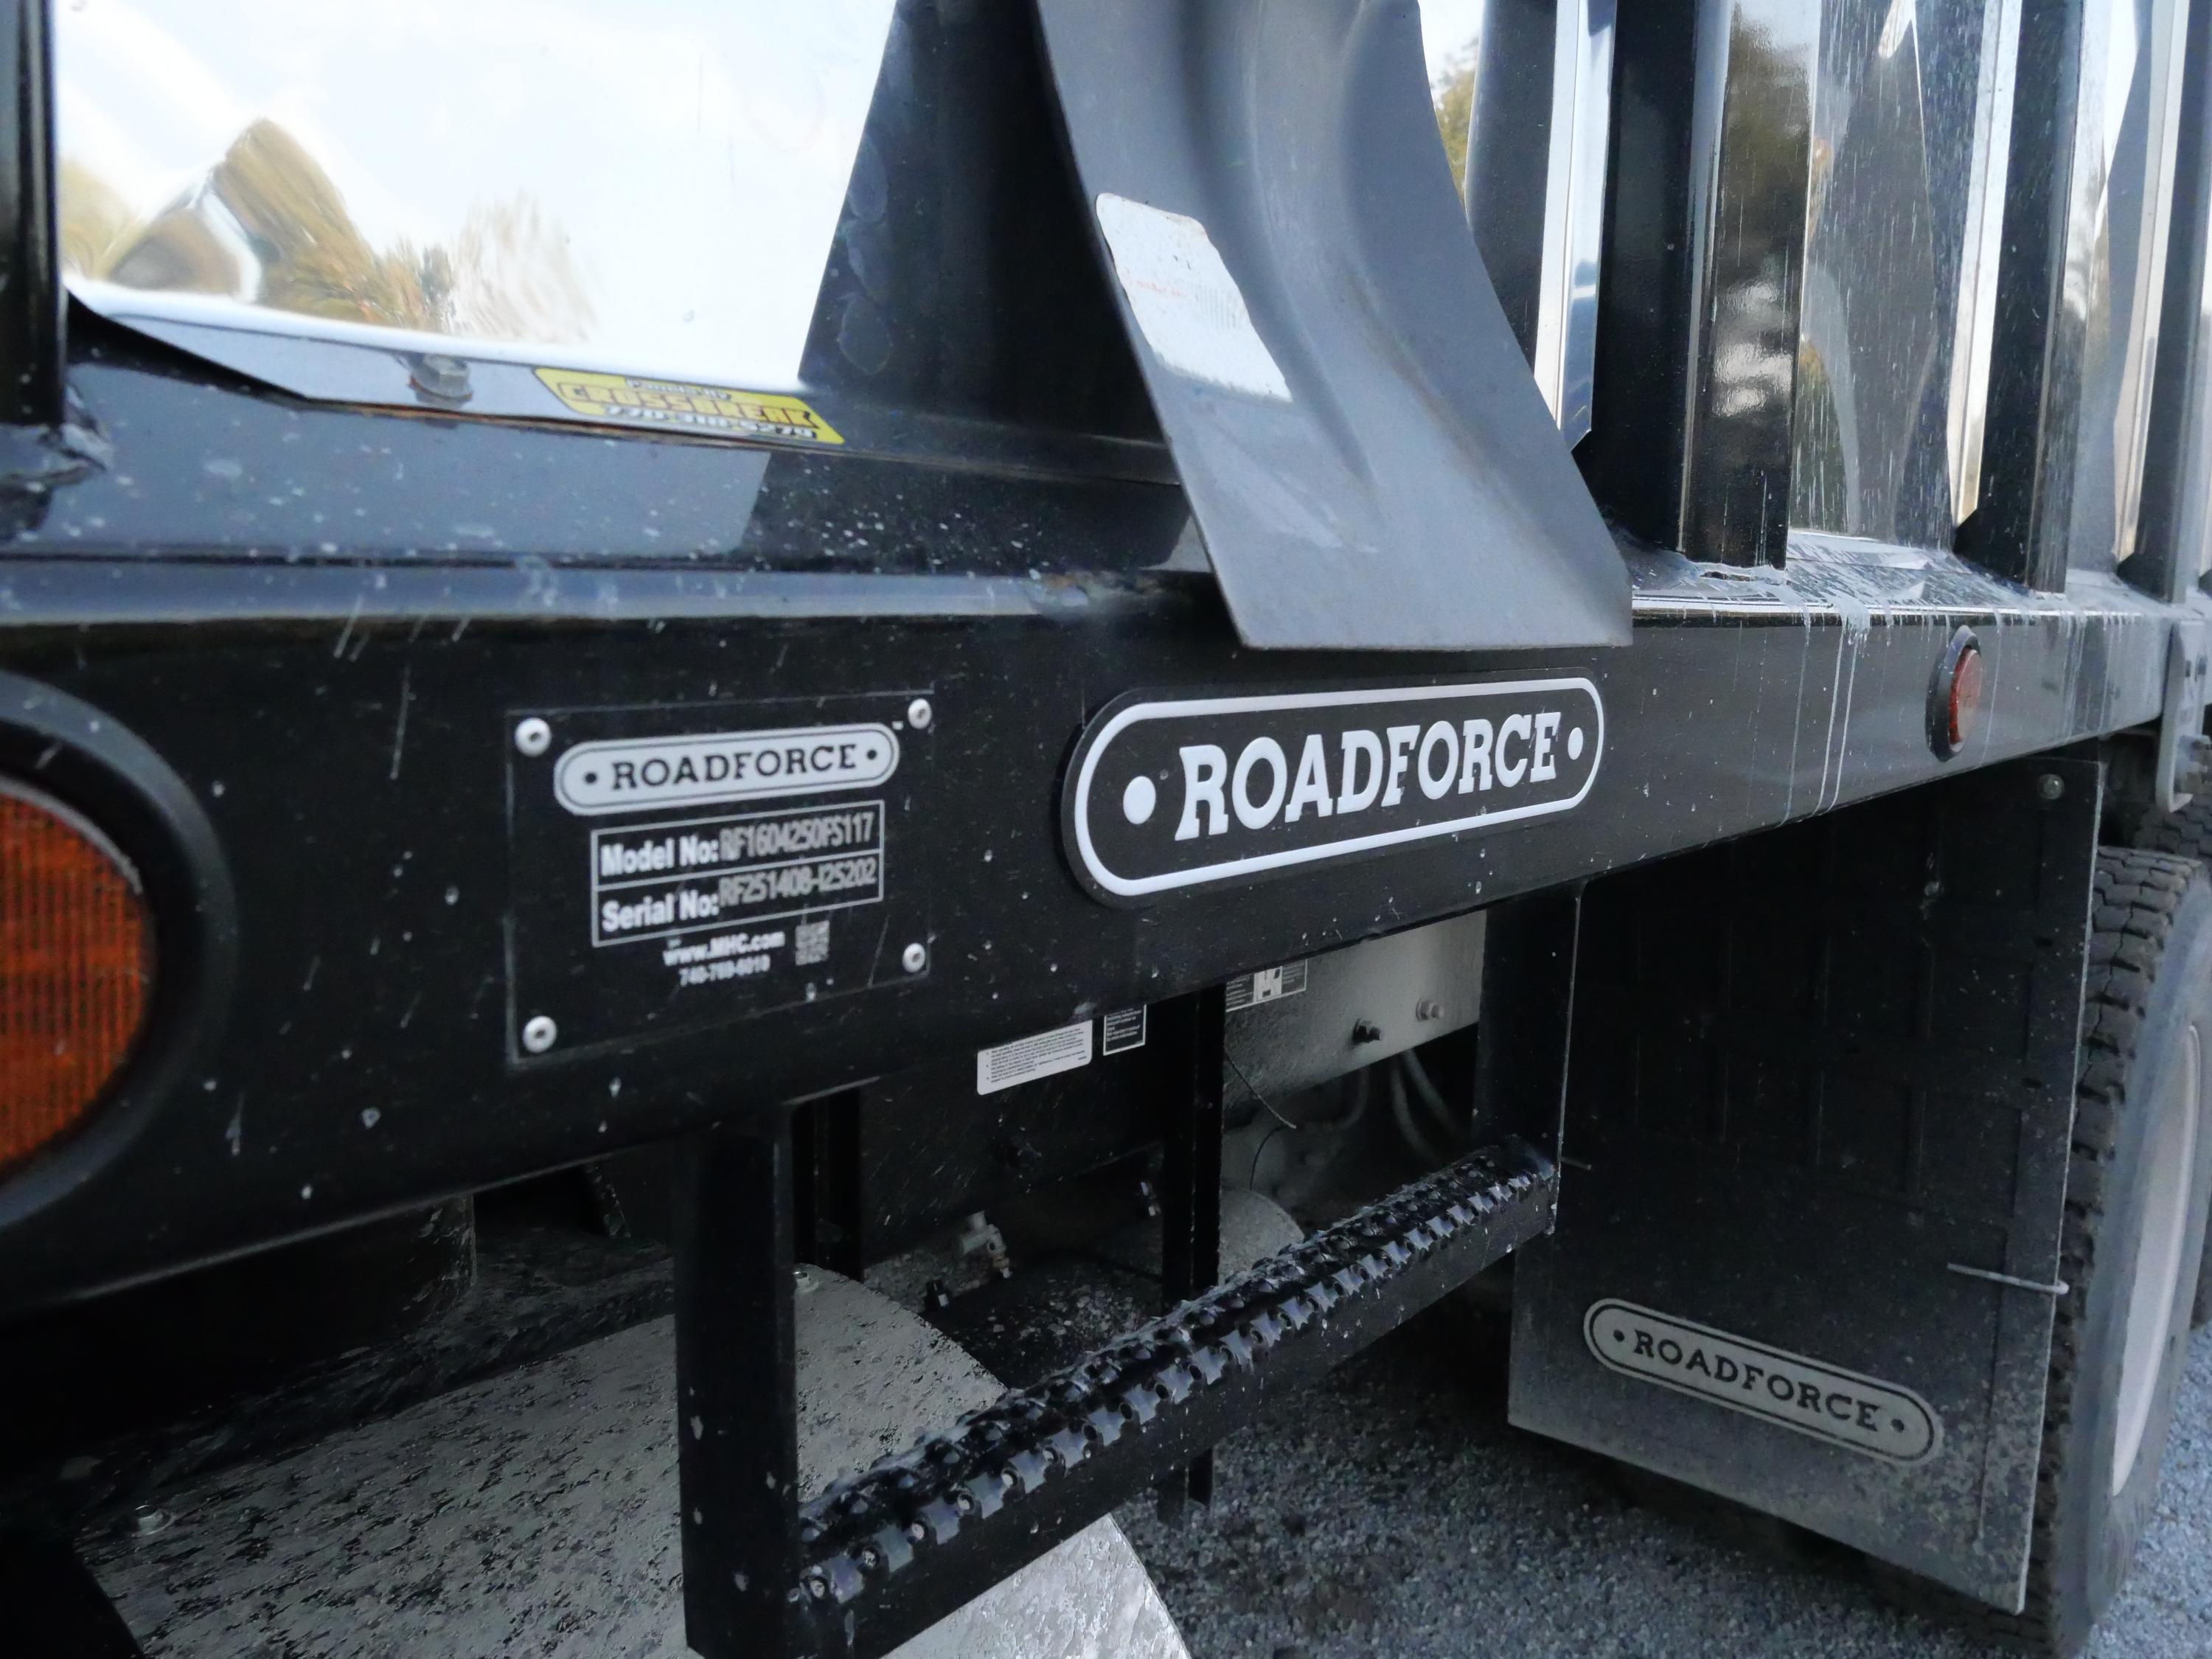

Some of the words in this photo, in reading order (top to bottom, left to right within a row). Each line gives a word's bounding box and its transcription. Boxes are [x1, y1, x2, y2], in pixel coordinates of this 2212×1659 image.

[611, 743, 857, 790] ROADFORCE
[1175, 711, 1562, 841] ROADFORCE
[600, 838, 674, 876] Model
[678, 835, 720, 868] No:
[601, 891, 674, 933] Serial
[678, 887, 720, 917] No:
[1632, 1328, 1883, 1432] ROADFORCE
